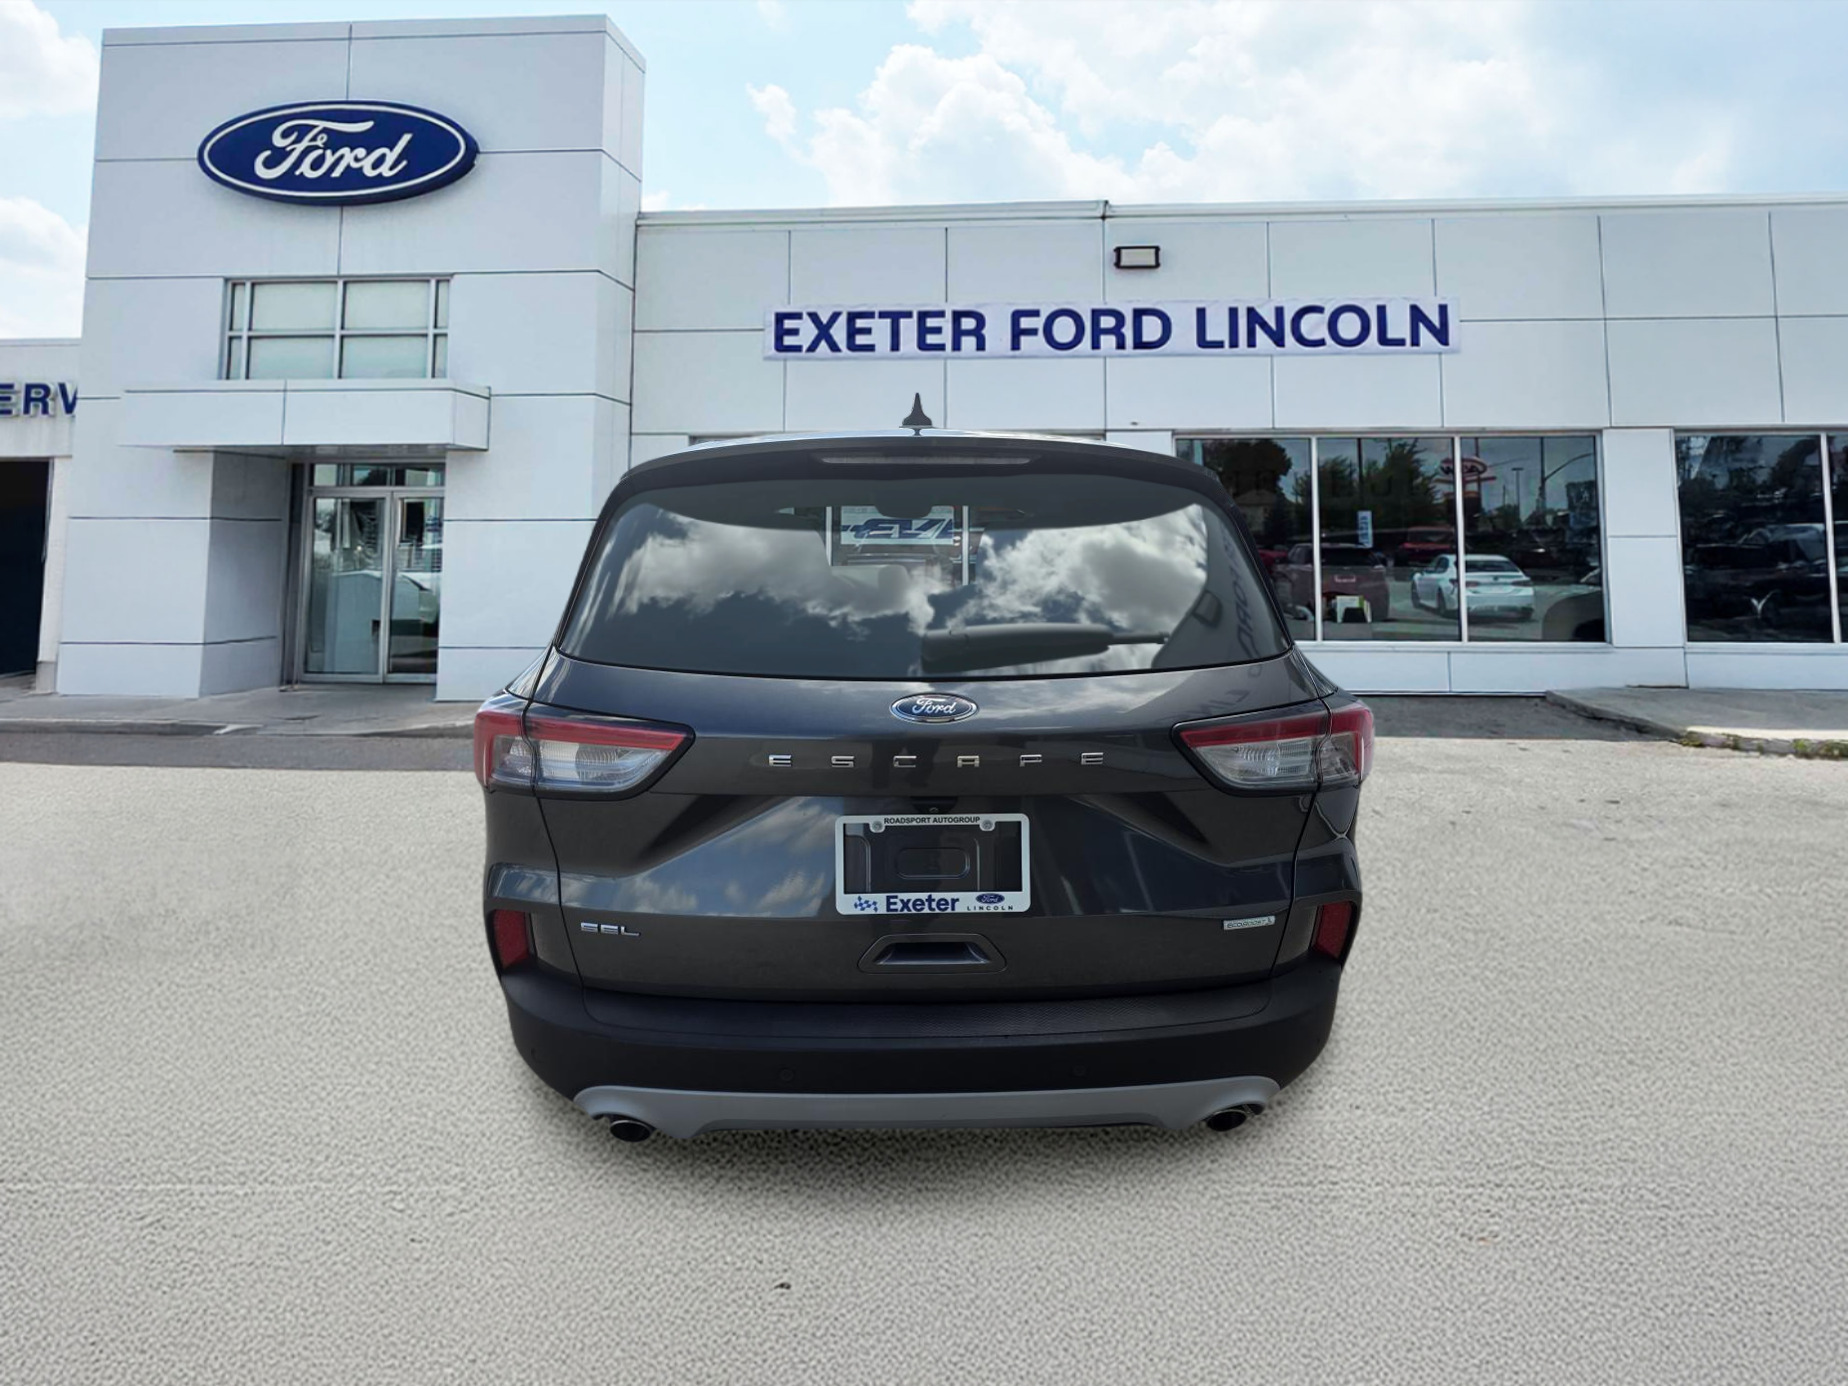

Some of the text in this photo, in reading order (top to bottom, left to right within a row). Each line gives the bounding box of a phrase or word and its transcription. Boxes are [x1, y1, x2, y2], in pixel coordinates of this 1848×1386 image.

[253, 118, 414, 180] Ford
[773, 302, 1451, 354] EXETER FORD LINCOLN
[911, 696, 957, 716] Ford
[768, 752, 1104, 768] ESCAPE
[883, 816, 981, 825] ROADSPORT AUTOGROUP
[885, 894, 960, 913] Exeter
